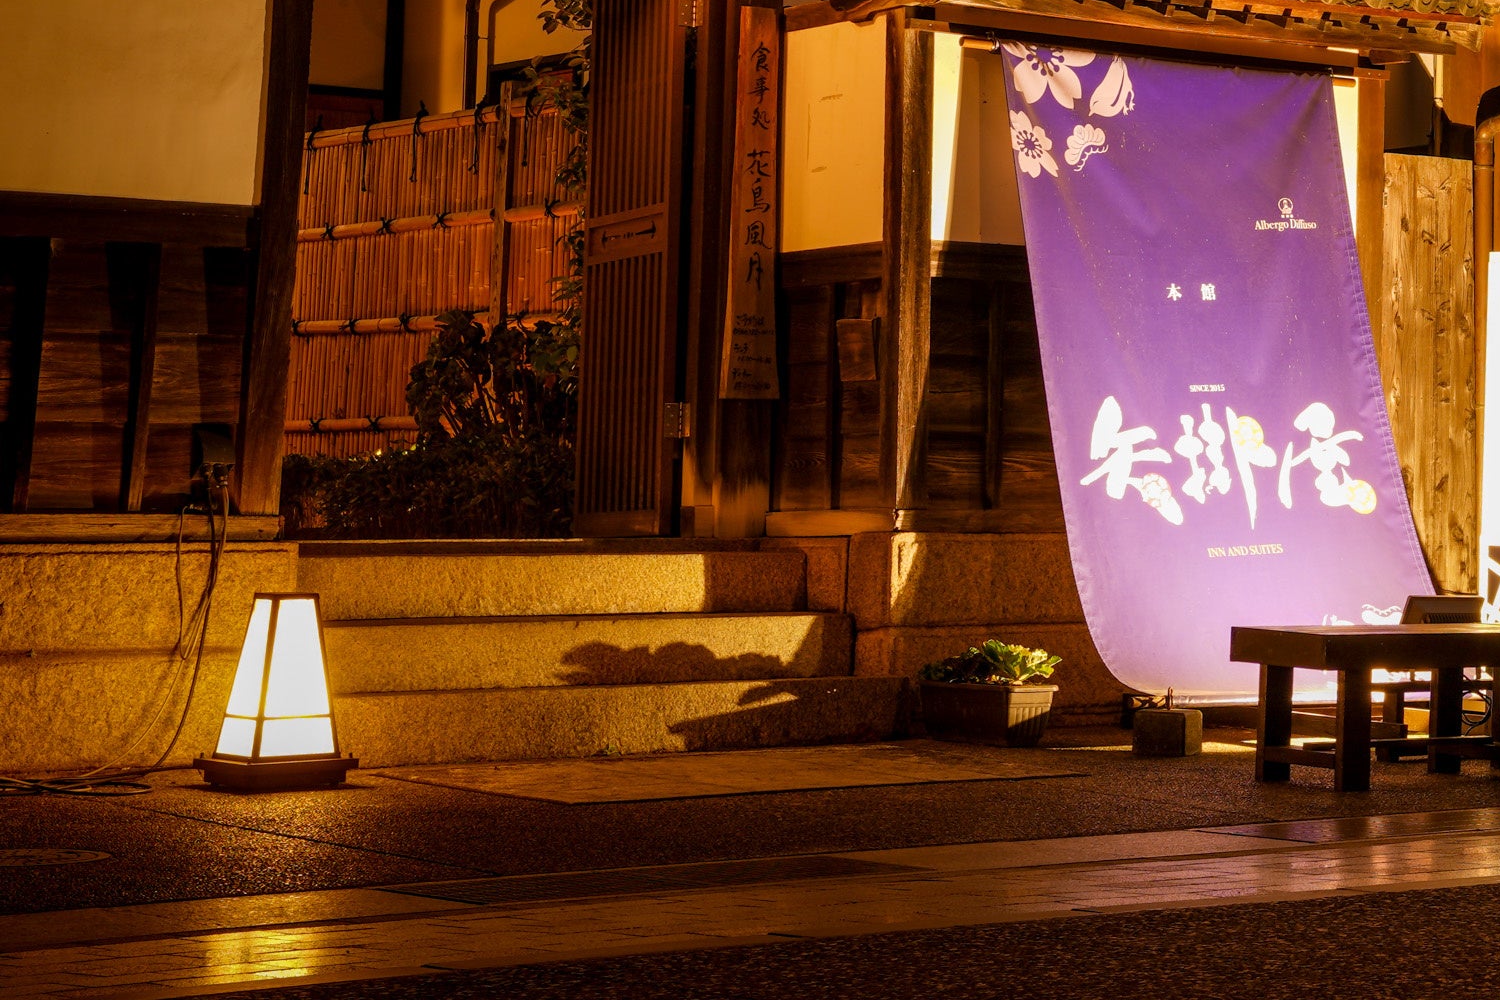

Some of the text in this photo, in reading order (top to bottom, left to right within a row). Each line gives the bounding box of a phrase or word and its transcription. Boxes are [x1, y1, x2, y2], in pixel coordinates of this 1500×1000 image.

[744, 41, 772, 291] 食事処 花鳥風月
[1255, 219, 1317, 231] Albergo Diffuso
[1166, 283, 1216, 301] 本館
[1189, 383, 1226, 392] SINCE 2015
[1080, 396, 1377, 530] 矢掛屋
[1207, 543, 1284, 558] INN AND SUITES
